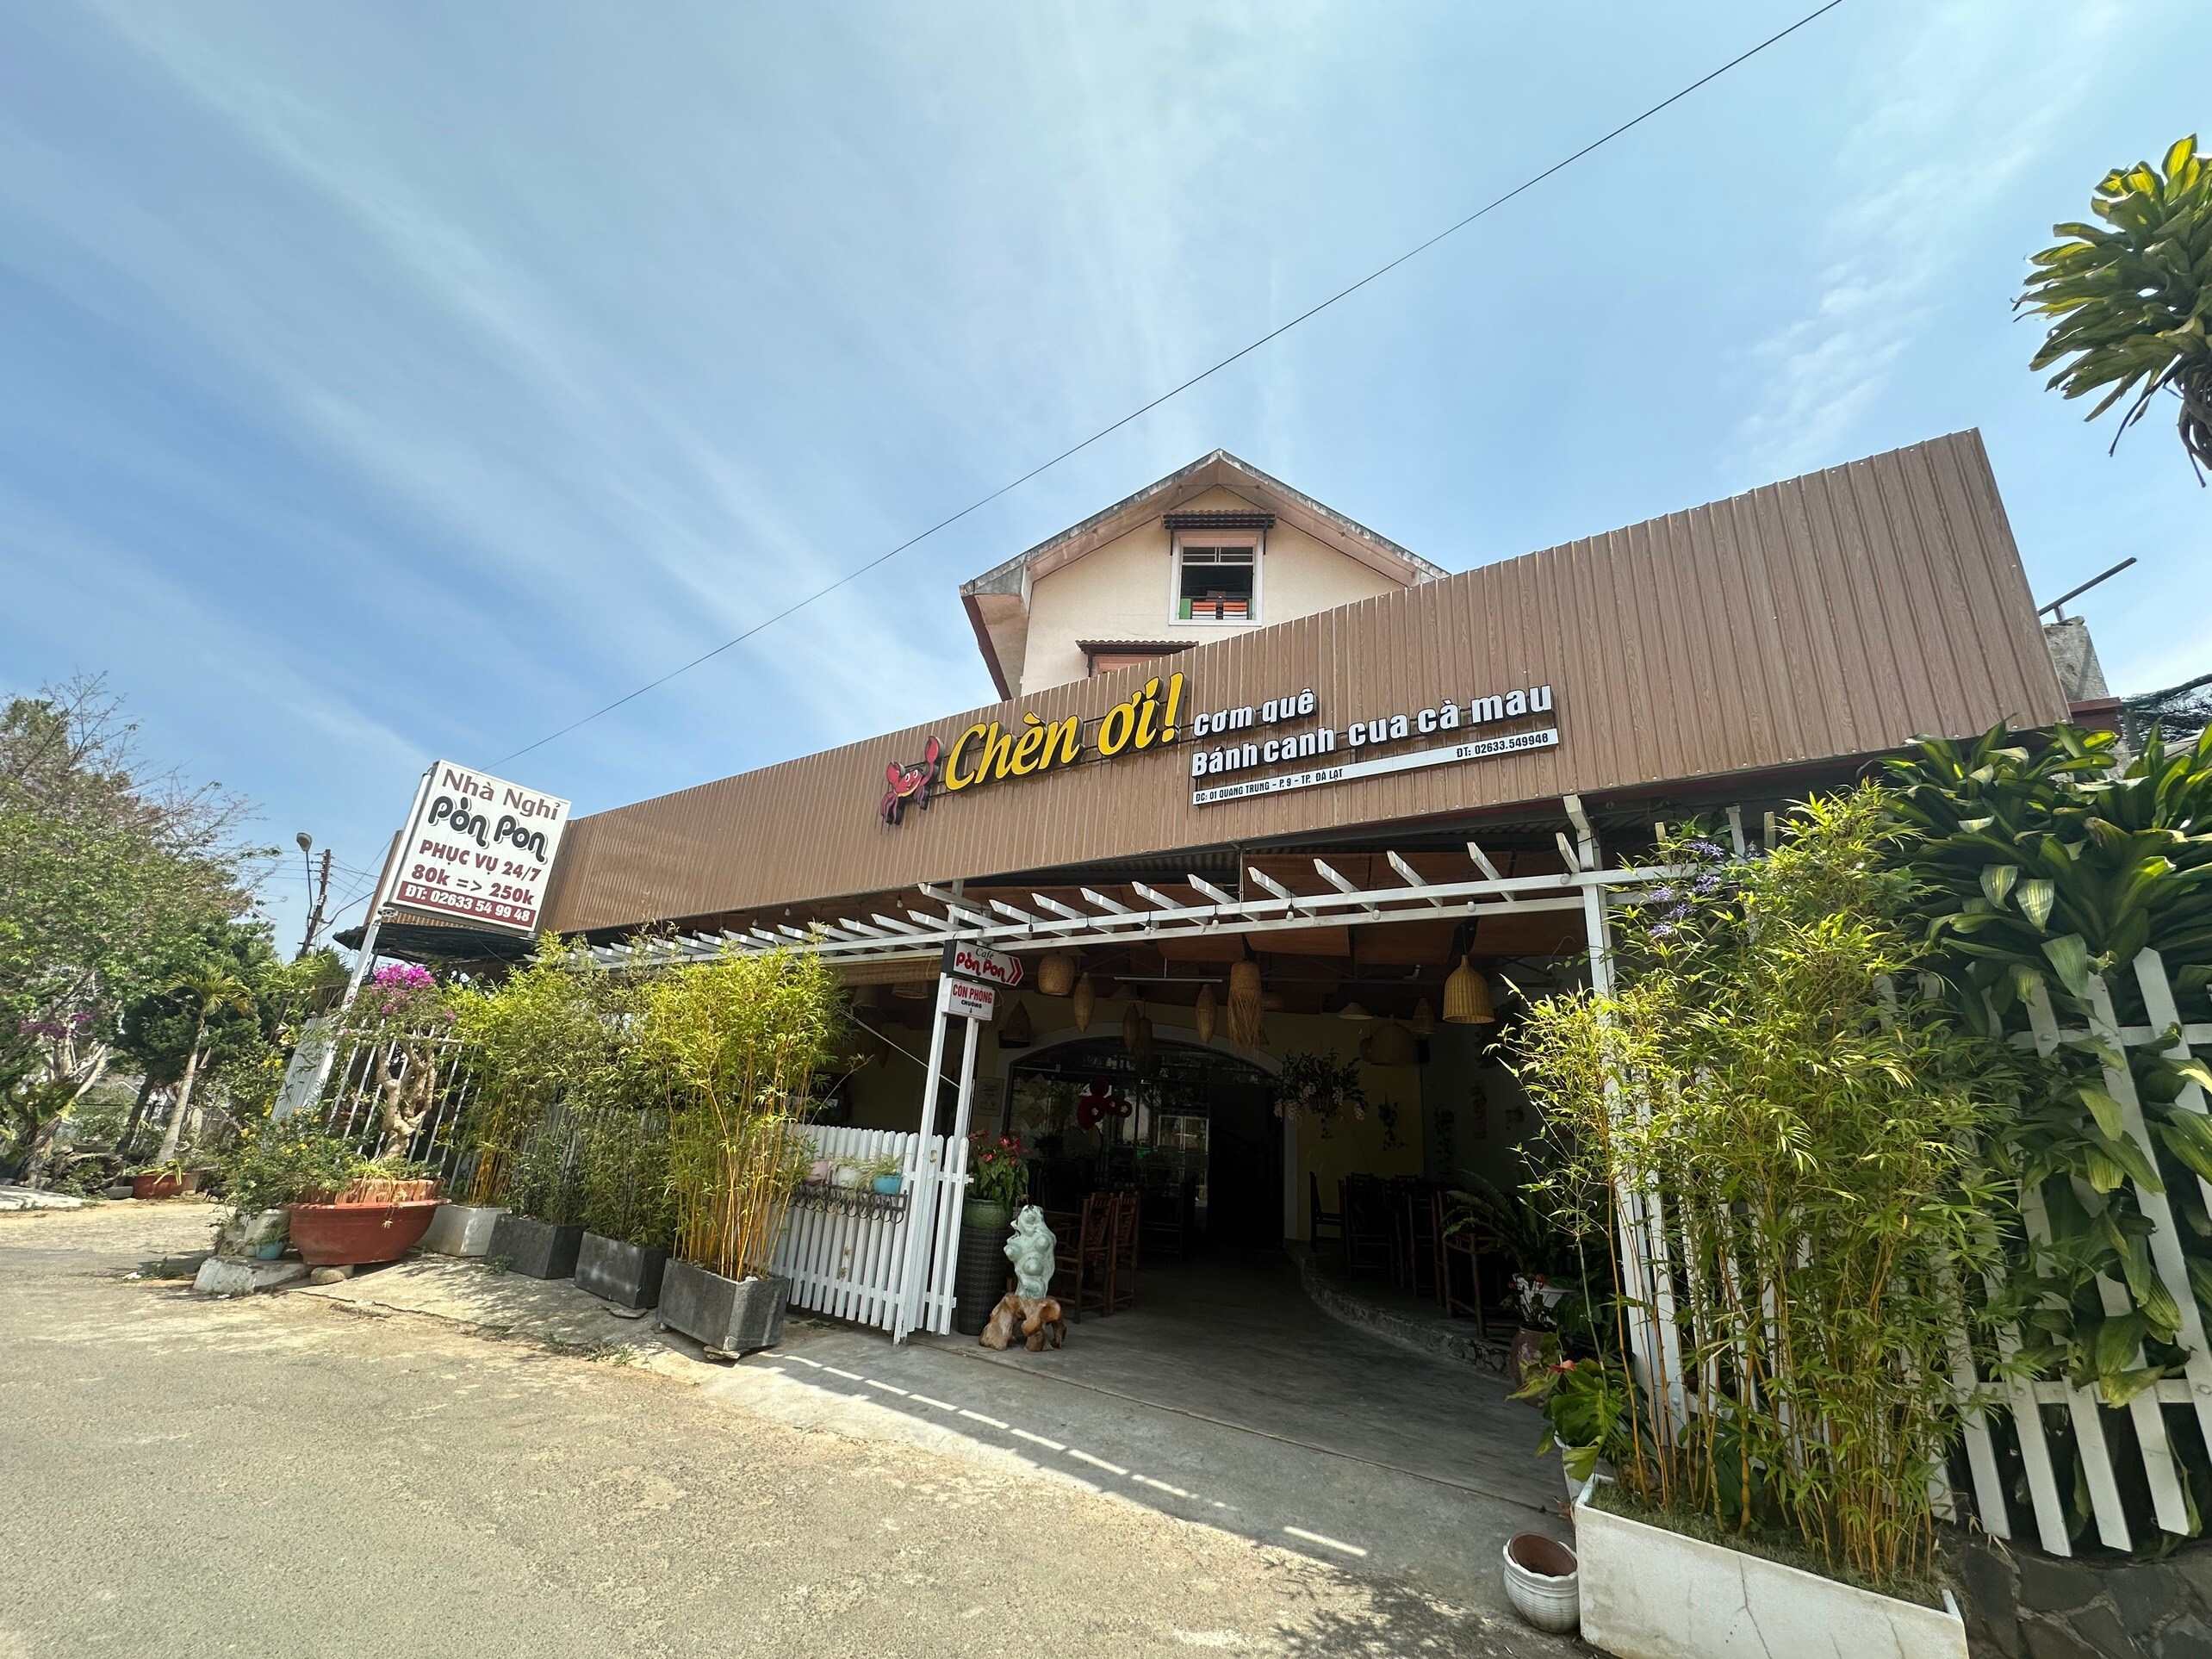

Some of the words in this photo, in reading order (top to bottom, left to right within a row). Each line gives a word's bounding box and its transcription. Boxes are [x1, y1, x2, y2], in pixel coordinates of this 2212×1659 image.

[1261, 688, 1315, 723] quê
[945, 711, 1082, 791] Chèn
[1097, 672, 1186, 756] ơi!
[1192, 743, 1258, 778] Bánh
[1264, 727, 1335, 763] canh
[1348, 713, 1409, 747] cua
[1417, 699, 1460, 733] cà
[1470, 685, 1552, 724] mau
[1457, 747, 1471, 758] ĐT:
[1475, 733, 1549, 755] 02633.549948
[442, 768, 495, 802] Nhà
[503, 788, 562, 821] Nghỉ
[1196, 793, 1208, 802] ĐC:
[1209, 791, 1217, 800] 01
[1219, 786, 1244, 798] QUANG
[1246, 781, 1270, 794] TRUNG
[1286, 779, 1291, 787] 9
[1301, 776, 1311, 785] TP.
[1315, 770, 1327, 782] ĐÀ
[1329, 768, 1344, 780] LẠT
[494, 815, 548, 864] Pon
[419, 839, 470, 866] PHỤC
[475, 853, 499, 875] VỤ
[501, 861, 542, 882] 24/7
[405, 884, 427, 901] ĐT:
[430, 890, 474, 910] 02633
[475, 899, 493, 914] 54
[494, 904, 512, 918] 99
[514, 908, 531, 922] 48
[411, 864, 450, 886] 80k
[488, 883, 536, 905] 250k
[976, 948, 995, 960] Café
[983, 959, 1006, 983] Pon
[953, 983, 968, 998] CÒN
[969, 987, 993, 1003] PHÒNG
